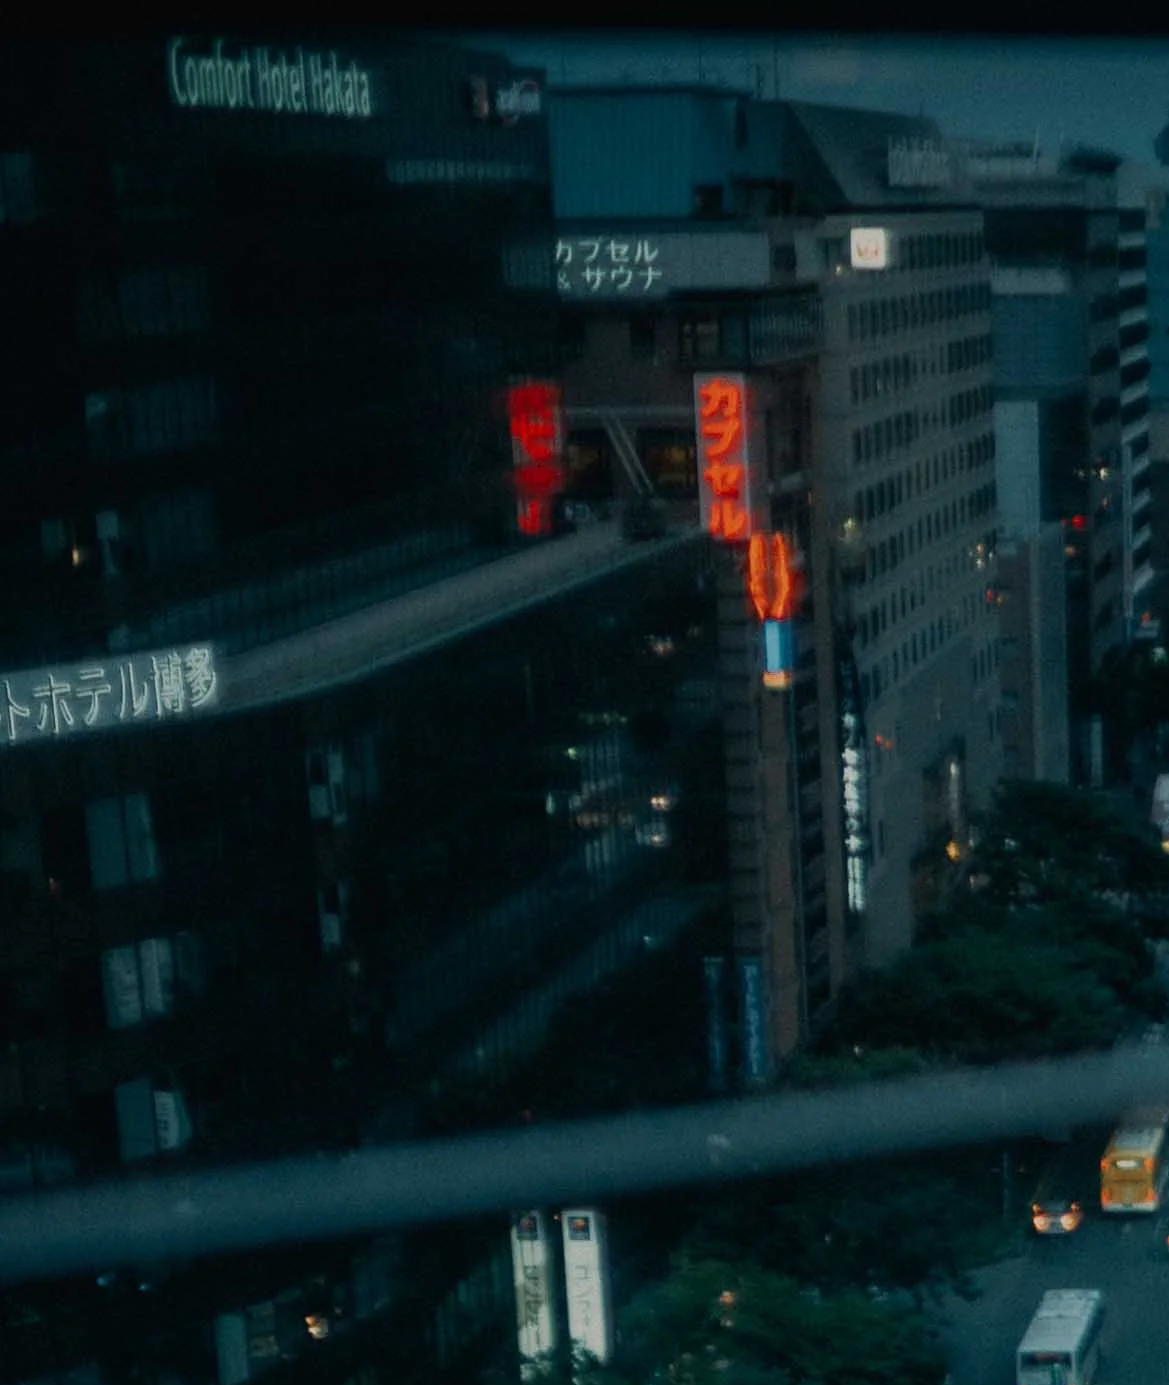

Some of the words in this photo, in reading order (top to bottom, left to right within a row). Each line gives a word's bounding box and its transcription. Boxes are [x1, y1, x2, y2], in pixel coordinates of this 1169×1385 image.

[170, 36, 253, 107] Comfort
[256, 47, 307, 112] Hotel
[309, 51, 370, 117] Hakata
[581, 266, 662, 291] サウナ
